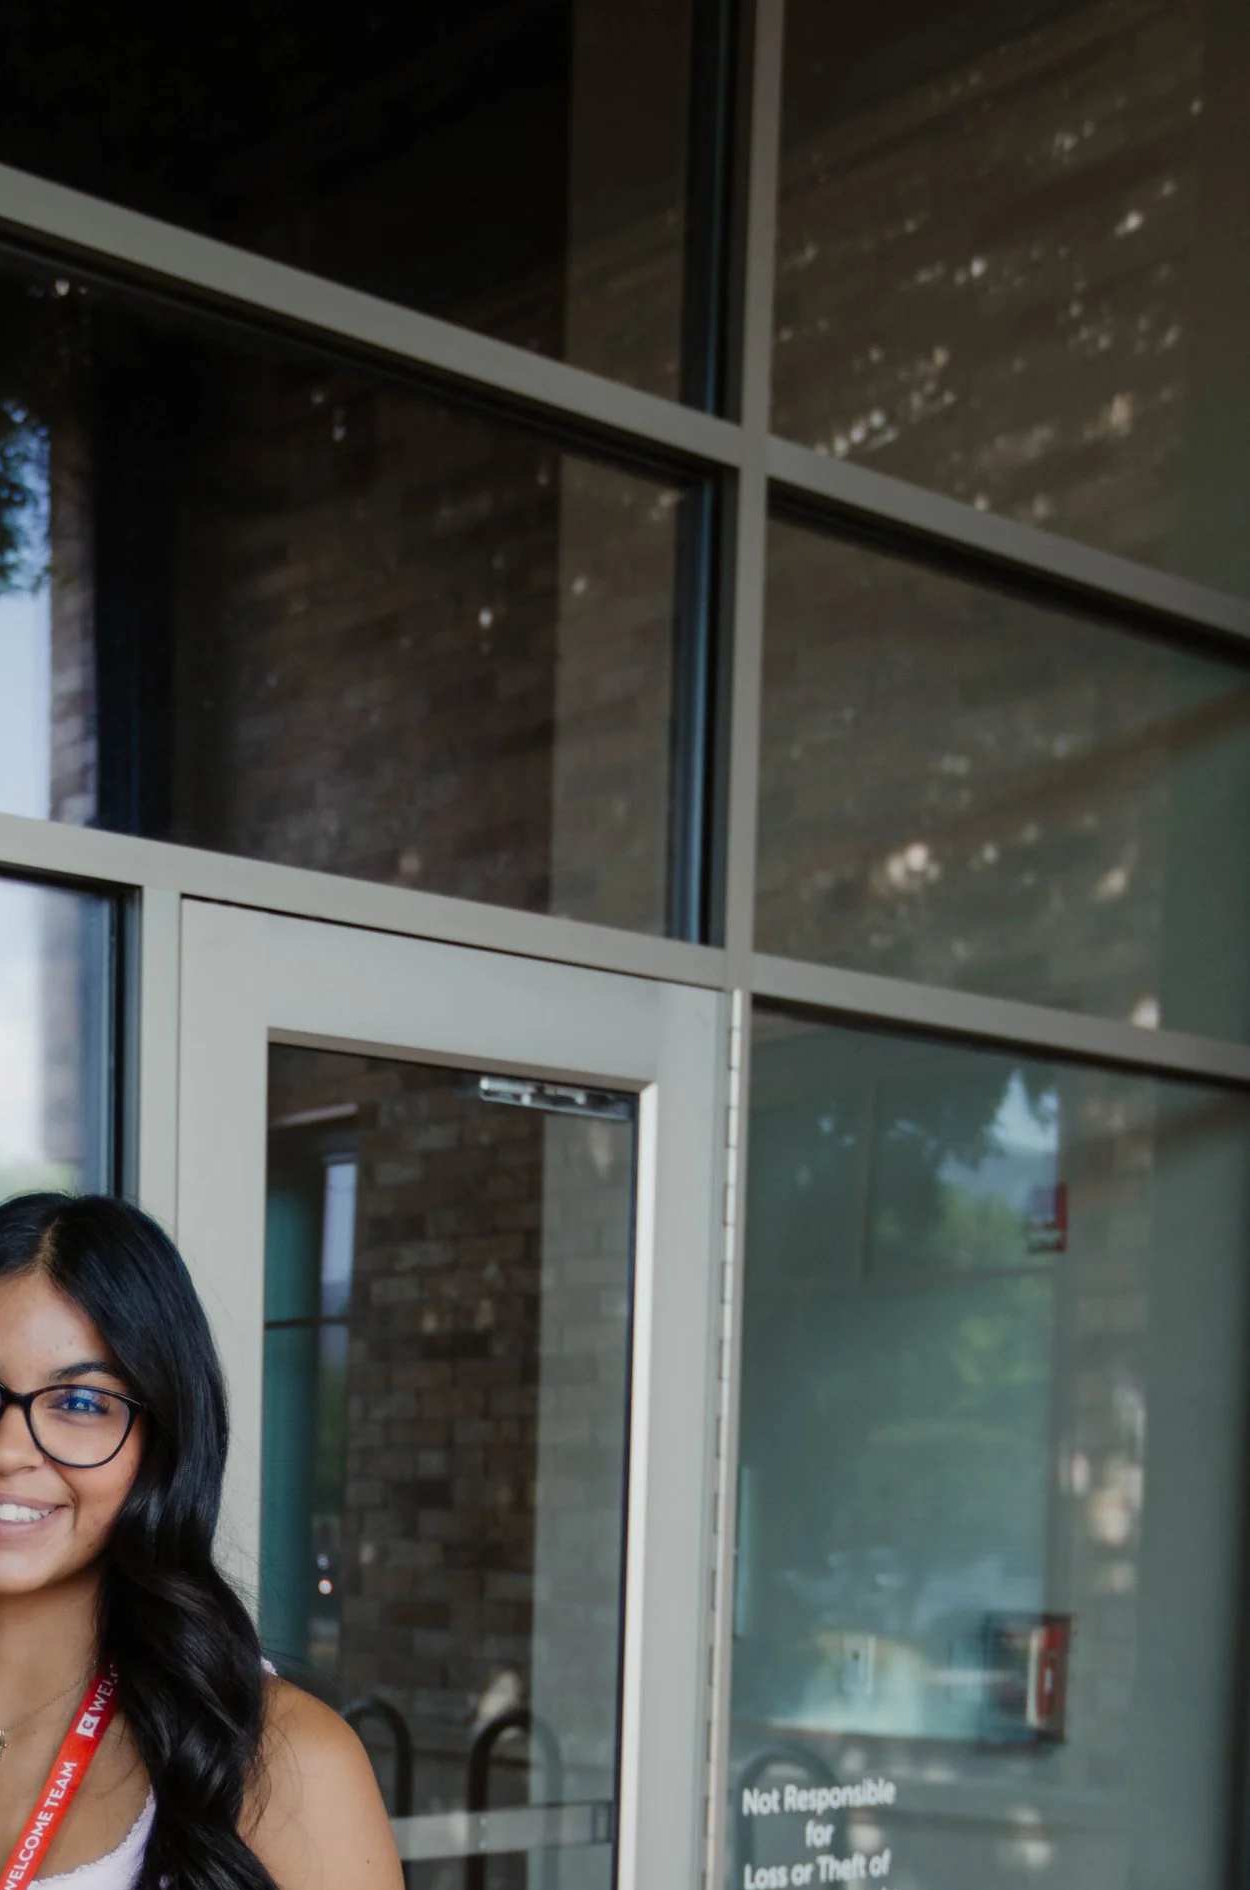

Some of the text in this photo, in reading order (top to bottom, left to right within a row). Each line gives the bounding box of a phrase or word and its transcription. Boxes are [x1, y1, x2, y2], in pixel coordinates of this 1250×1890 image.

[45, 1760, 78, 1814] TEAM
[742, 1776, 897, 1816] Not Responsible
[805, 1819, 835, 1848] for
[790, 1862, 814, 1887] or
[816, 1851, 867, 1883] Theft
[869, 1847, 892, 1879] of
